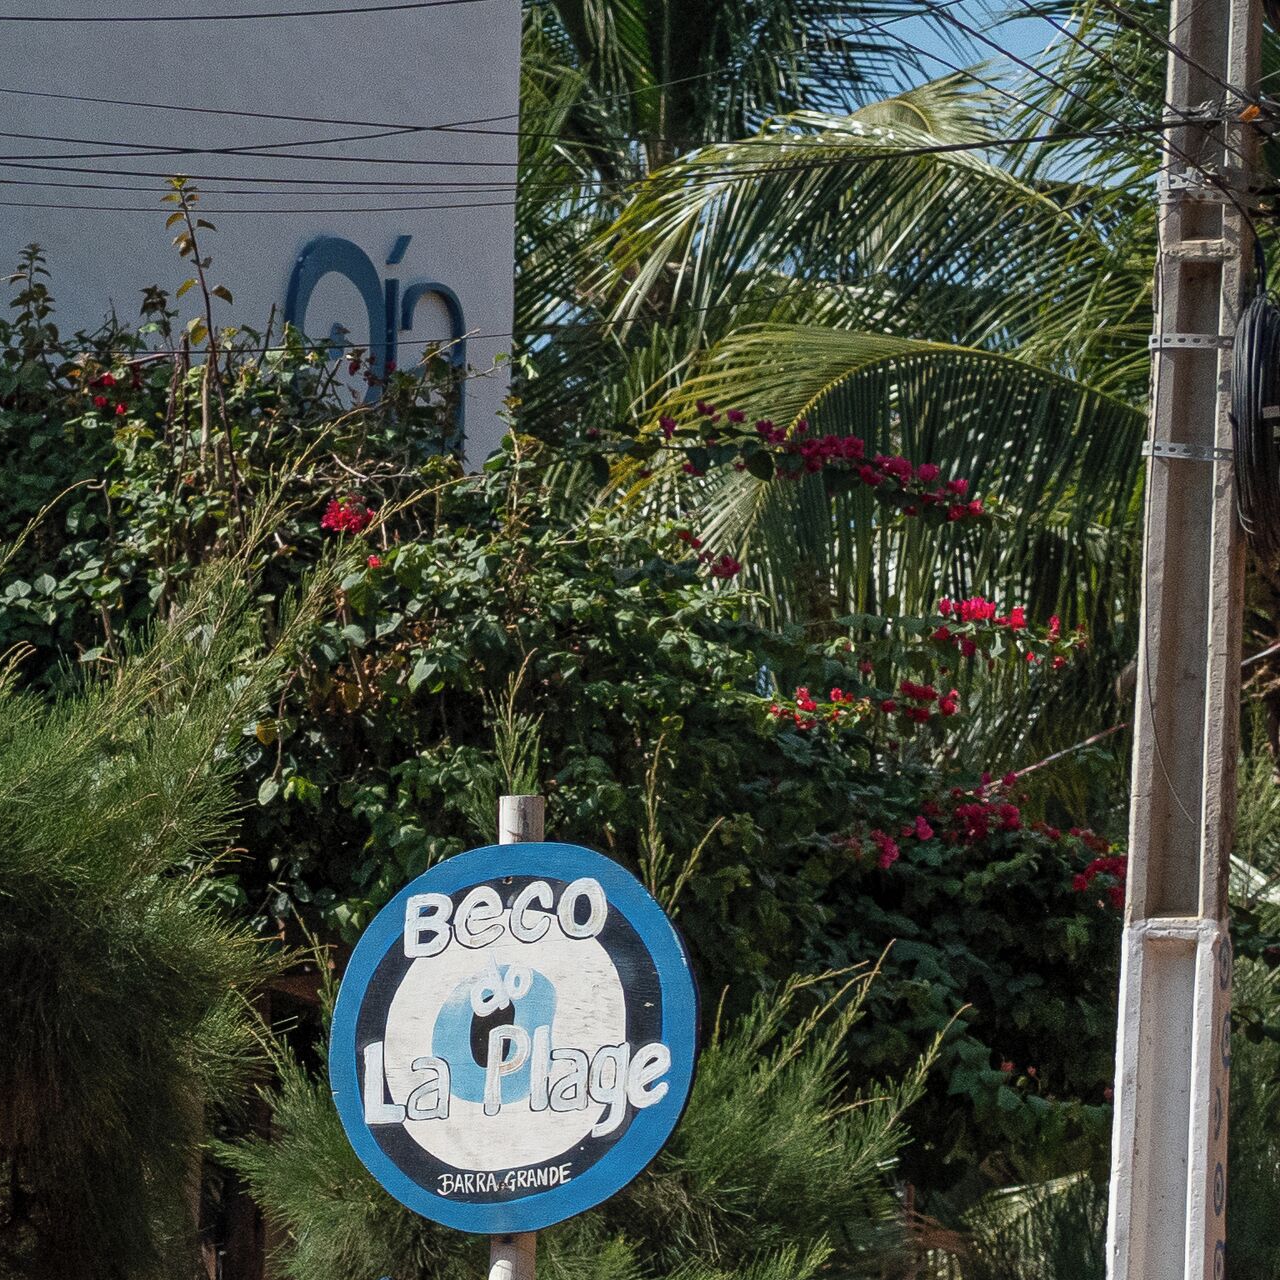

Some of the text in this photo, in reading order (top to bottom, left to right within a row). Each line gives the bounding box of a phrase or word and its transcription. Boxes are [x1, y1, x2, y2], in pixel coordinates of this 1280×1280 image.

[470, 953, 535, 1017] do
[362, 1024, 672, 1138] La Plage
[436, 1162, 573, 1196] BARRA GRANDE
